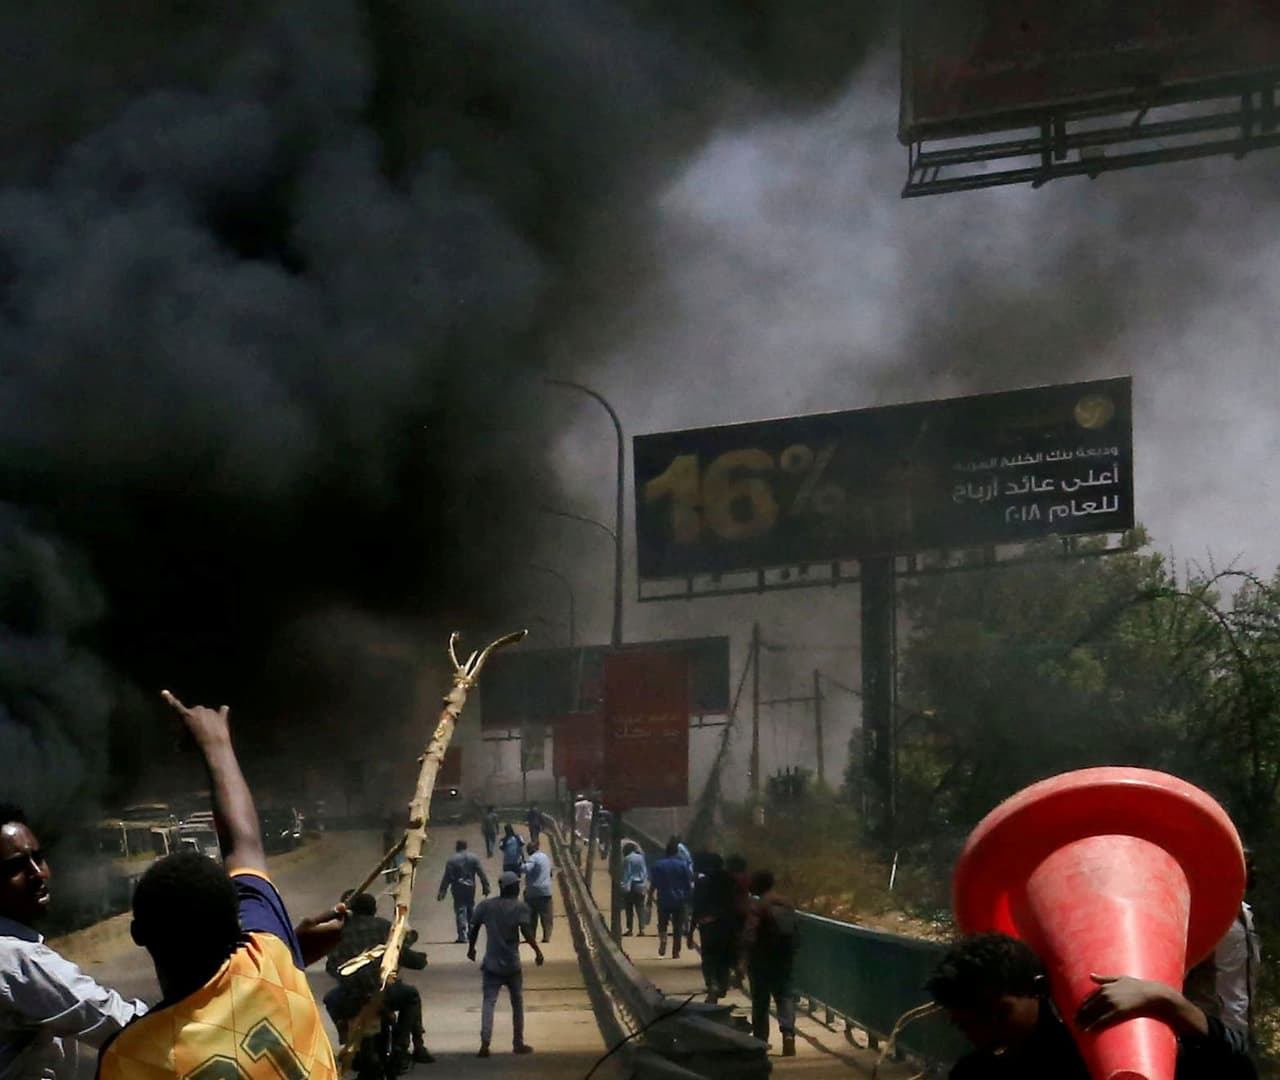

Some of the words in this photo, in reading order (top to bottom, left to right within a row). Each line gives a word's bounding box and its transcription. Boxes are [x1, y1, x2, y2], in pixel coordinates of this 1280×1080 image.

[1061, 463, 1119, 491] أعلى
[646, 443, 846, 546] 16%
[1049, 494, 1119, 523] للعام
